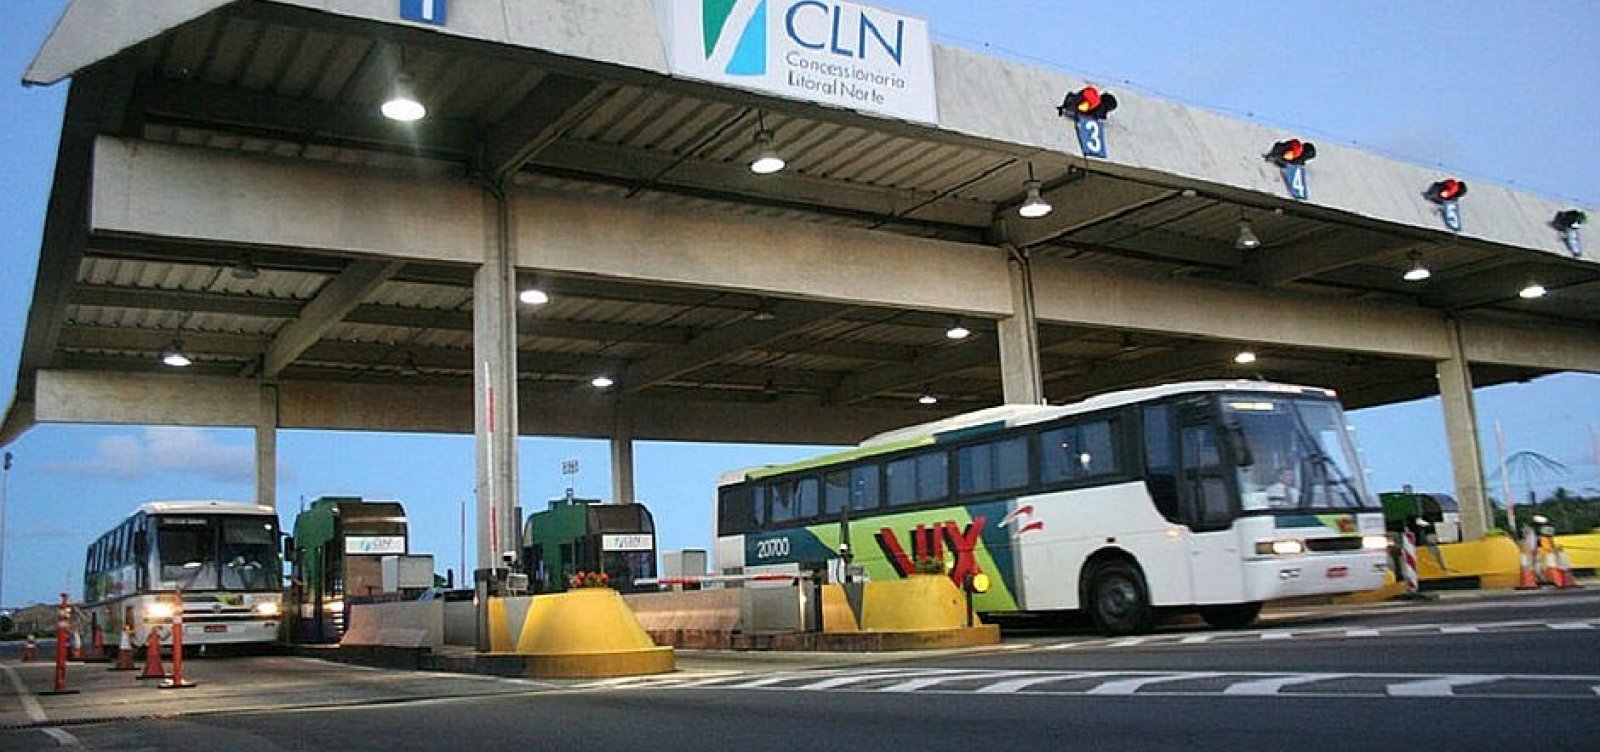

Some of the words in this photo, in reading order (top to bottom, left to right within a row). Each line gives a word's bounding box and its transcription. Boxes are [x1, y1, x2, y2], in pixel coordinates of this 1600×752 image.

[785, 0, 904, 66] CLN
[788, 70, 837, 95] Litoral
[840, 82, 884, 104] Norte
[1085, 121, 1101, 151] 3
[1292, 168, 1304, 198] 4
[1446, 204, 1458, 228] 5
[758, 537, 790, 558] 20700
[874, 516, 986, 589] VIX
